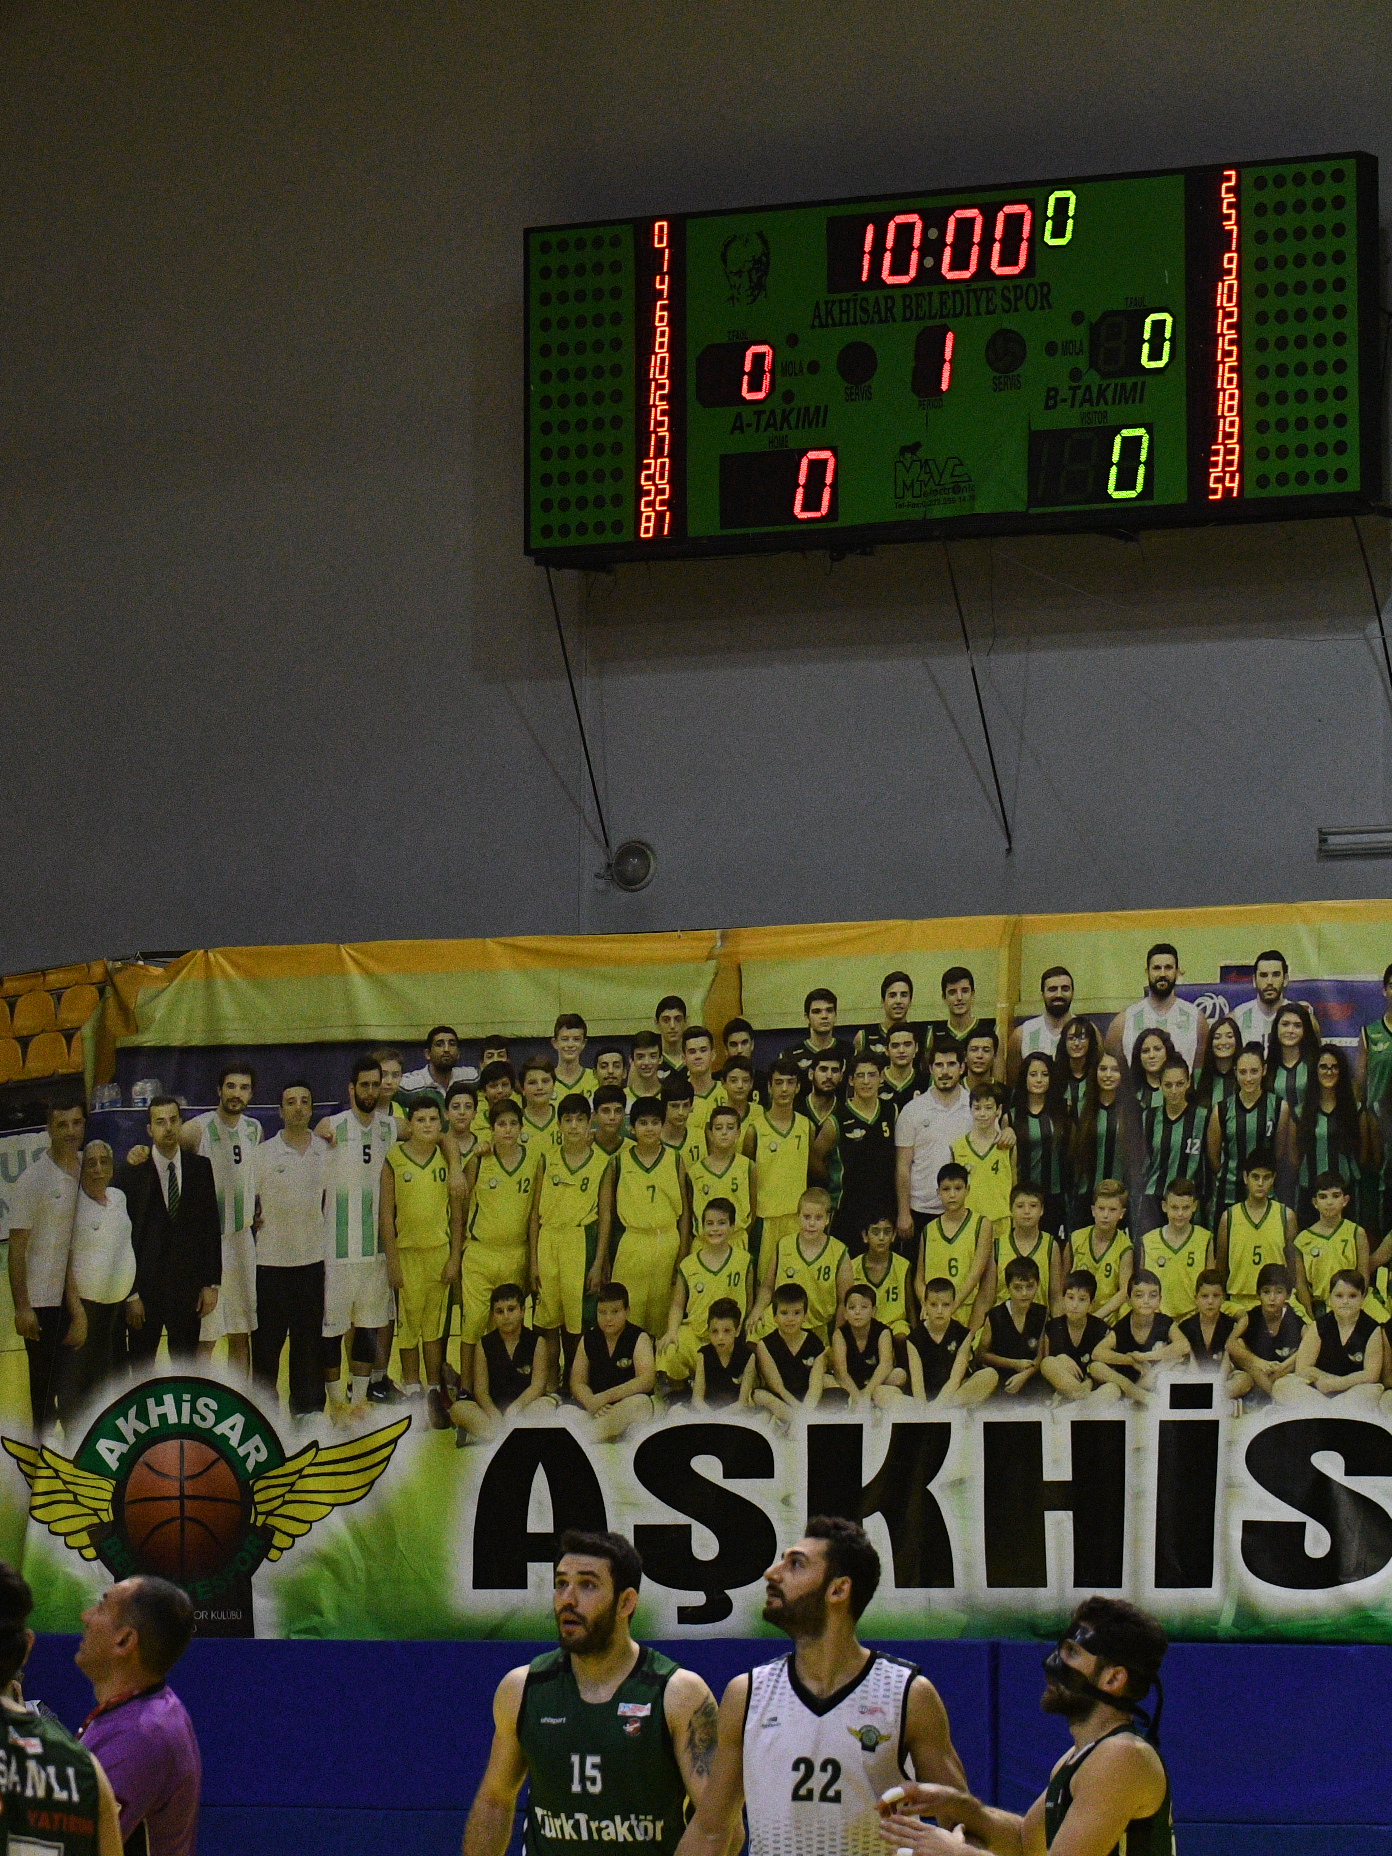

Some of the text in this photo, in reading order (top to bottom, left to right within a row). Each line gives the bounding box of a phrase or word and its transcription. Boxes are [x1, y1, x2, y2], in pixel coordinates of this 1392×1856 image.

[1221, 170, 1236, 198] 2
[1044, 190, 1076, 246] 0
[1222, 197, 1237, 225] 5
[654, 221, 669, 247] 0
[861, 203, 1033, 285] 10:00
[1223, 226, 1238, 251] 7
[663, 249, 670, 272] 1
[1223, 252, 1238, 279] 9
[655, 275, 669, 299] 4
[1001, 282, 1053, 314] SPOR
[1216, 279, 1238, 307] 10
[654, 300, 669, 326] 6
[1216, 307, 1238, 334] 12
[655, 327, 669, 352] 8
[1141, 312, 1173, 368] 0
[1216, 335, 1238, 361] 15
[649, 353, 669, 378] 10
[741, 344, 774, 401] 0
[940, 331, 954, 392] 1
[1216, 361, 1239, 389] 16
[649, 379, 669, 405] 12
[1044, 382, 1146, 410] B-TAKIMI
[1216, 389, 1239, 416] 18
[649, 405, 669, 431] 15
[730, 406, 828, 435] A-TAKIMI
[1217, 416, 1240, 443] 19
[649, 432, 669, 457] 17
[640, 458, 669, 484] 20
[1107, 427, 1150, 499] 0
[1209, 444, 1240, 472] 33
[793, 449, 836, 520] 0
[1208, 472, 1240, 500] 54
[640, 485, 669, 511] 22
[640, 511, 670, 538] 81
[794, 1134, 802, 1151] 7
[881, 1121, 890, 1138] 5
[233, 1144, 242, 1165] 9
[362, 1144, 372, 1165] 5
[1184, 1138, 1201, 1155] 12
[431, 1167, 446, 1183] 10
[990, 1159, 999, 1175] 4
[516, 1177, 531, 1194] 12
[580, 1177, 590, 1193] 8
[646, 1184, 656, 1203] 7
[730, 1177, 739, 1193] 5
[1186, 1251, 1194, 1267] 5
[1251, 1245, 1262, 1265] 5
[1340, 1238, 1349, 1255] 7
[726, 1271, 741, 1287] 10
[816, 1265, 831, 1282] 18
[947, 1257, 959, 1277] 6
[1103, 1262, 1113, 1278] 9
[885, 1286, 899, 1302] 15
[570, 1752, 603, 1795] 15
[791, 1757, 842, 1804] 22
